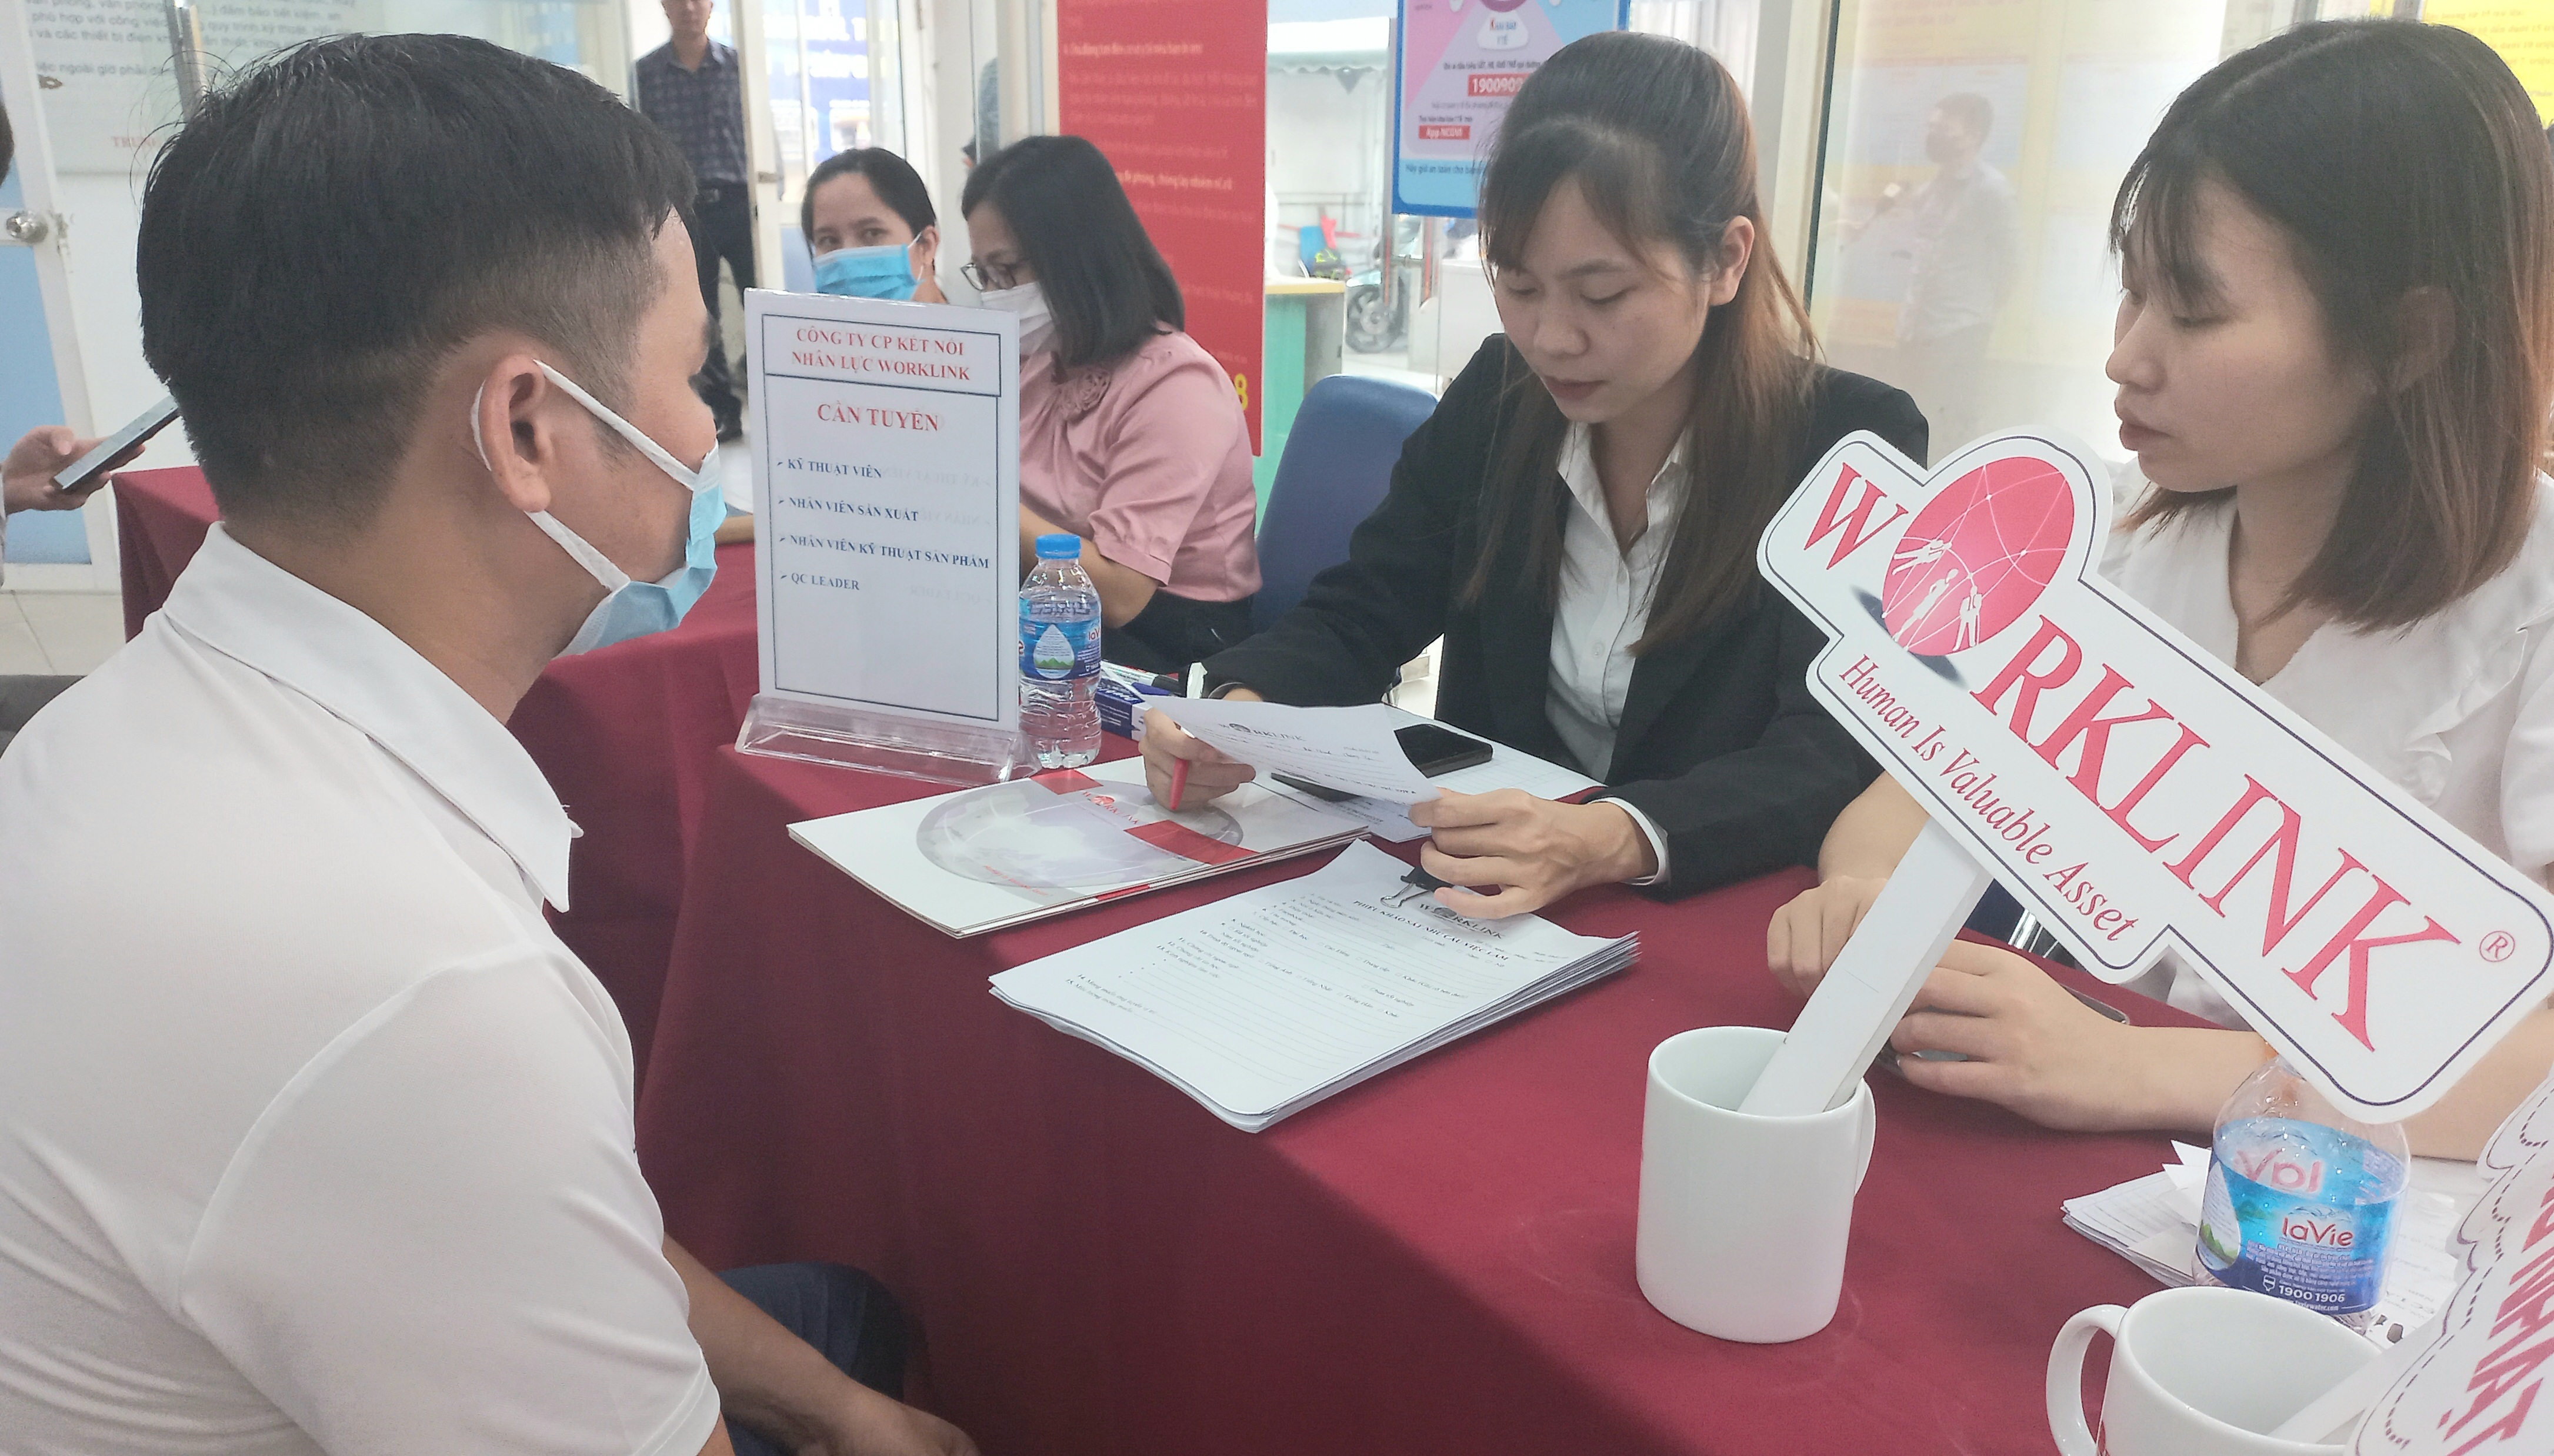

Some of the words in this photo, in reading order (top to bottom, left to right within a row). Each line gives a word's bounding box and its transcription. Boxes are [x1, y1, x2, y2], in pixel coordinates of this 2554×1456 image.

[1473, 77, 1528, 93] 1900909
[796, 325, 842, 345] CÔNG
[847, 332, 866, 347] TY
[871, 335, 893, 349] CP
[898, 334, 929, 353] KẾT
[933, 338, 965, 356] NỐI
[791, 349, 836, 368] NHÂN
[840, 355, 873, 374] LỰC
[877, 359, 971, 381] WORKLINK
[816, 400, 862, 424] CẦN
[788, 457, 803, 470] KỸ
[808, 460, 849, 477] THUẬT
[853, 463, 883, 479] VIÊN
[789, 496, 823, 510] NHÂN
[825, 500, 855, 514] VIÊN
[858, 503, 882, 517] SẢN
[885, 506, 919, 522] XUẤT
[789, 534, 824, 549] NHÂN
[826, 537, 856, 552] VIÊN
[859, 542, 877, 556] KỸ
[880, 545, 922, 562] THUẬT
[924, 549, 949, 565] SẢN
[952, 553, 989, 569] PHẨM
[791, 572, 808, 585] QC
[811, 575, 860, 591] LEADER
[1839, 654, 1918, 740] Human
[1913, 722, 1946, 763] Is
[1939, 747, 2054, 864] Valuable
[2044, 860, 2139, 943] Asset
[2282, 1216, 2354, 1247] laVie
[2279, 1285, 2312, 1300] 1900
[2315, 1293, 2346, 1303] 1906
